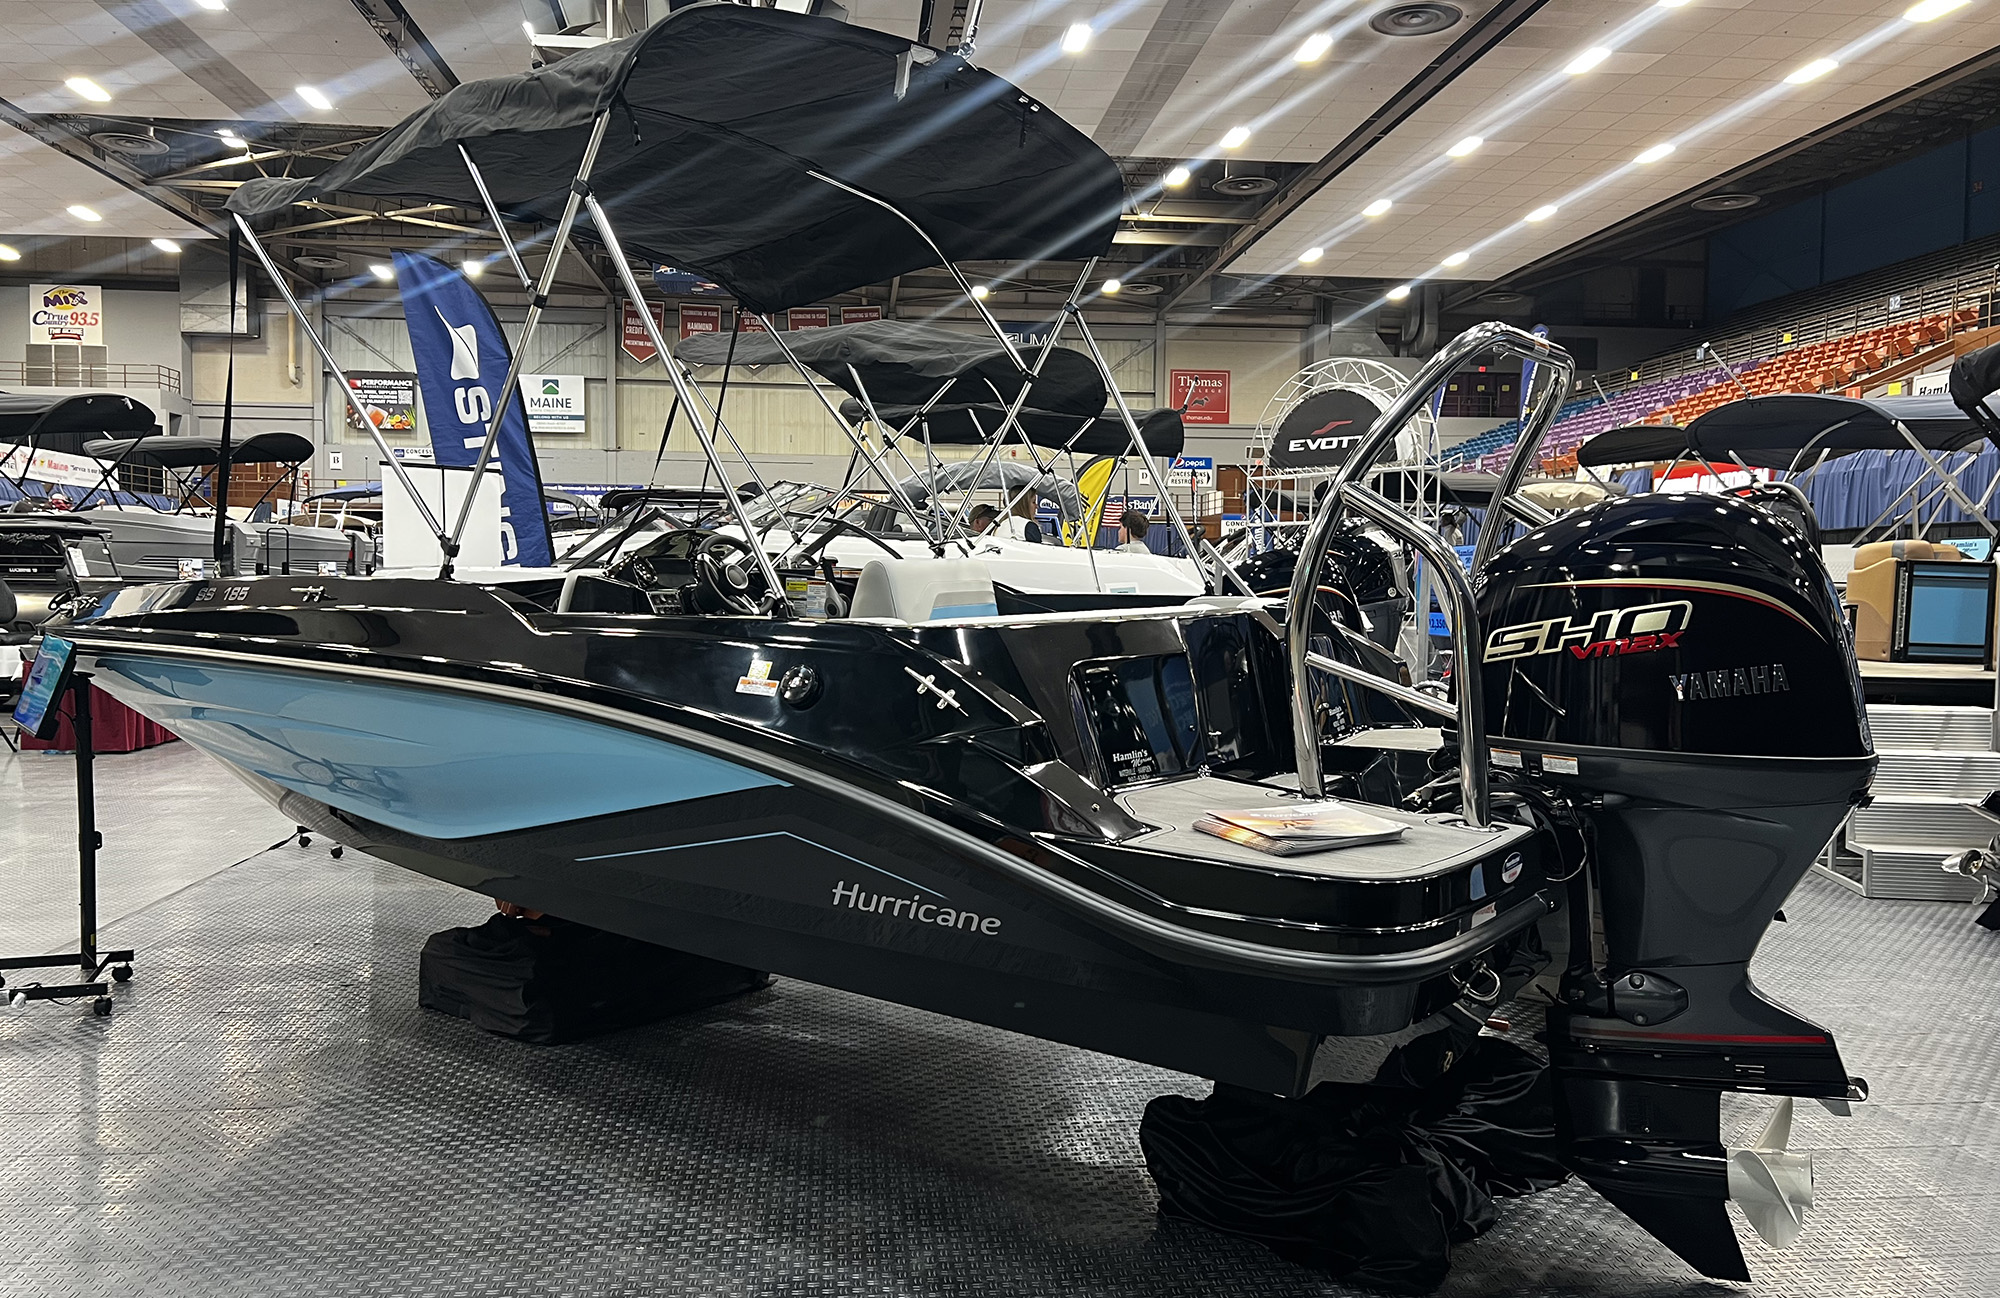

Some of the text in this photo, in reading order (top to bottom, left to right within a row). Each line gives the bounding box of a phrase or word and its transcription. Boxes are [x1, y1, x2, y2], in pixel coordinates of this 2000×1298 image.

[69, 311, 99, 326] 93.5
[626, 326, 642, 334] CREDIT
[687, 322, 712, 331] HAMMOND
[362, 379, 412, 387] PERFORMANCE
[530, 398, 572, 408] MAINE
[196, 586, 250, 600] SS 185
[1483, 600, 1693, 663] SHO
[1669, 664, 1790, 701] YAMAHA
[1112, 749, 1148, 762] Hamlin's
[832, 880, 1001, 936] Hurricane
